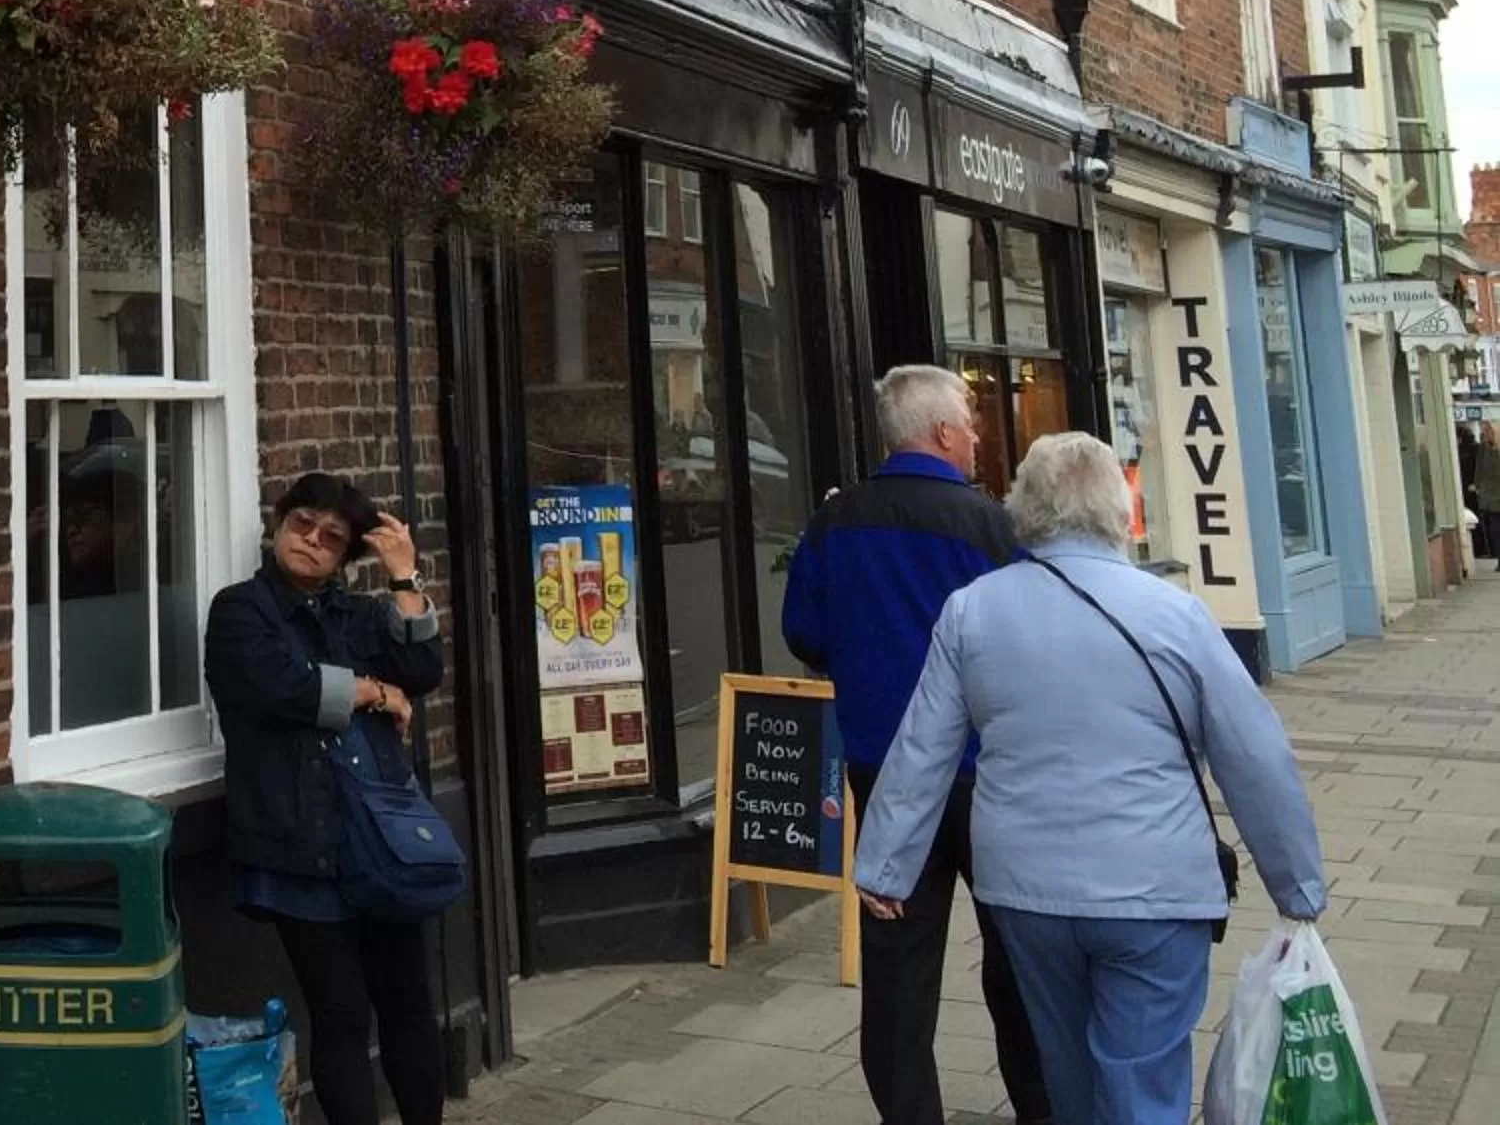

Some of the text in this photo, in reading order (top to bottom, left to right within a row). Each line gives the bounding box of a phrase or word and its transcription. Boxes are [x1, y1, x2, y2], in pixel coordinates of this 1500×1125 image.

[890, 98, 912, 163] 69
[959, 133, 1026, 205] eastgate
[1348, 289, 1435, 305] Ashley Blinds
[1171, 296, 1237, 586] TRAVEL
[536, 506, 596, 527] ROUND
[558, 496, 581, 508] THE
